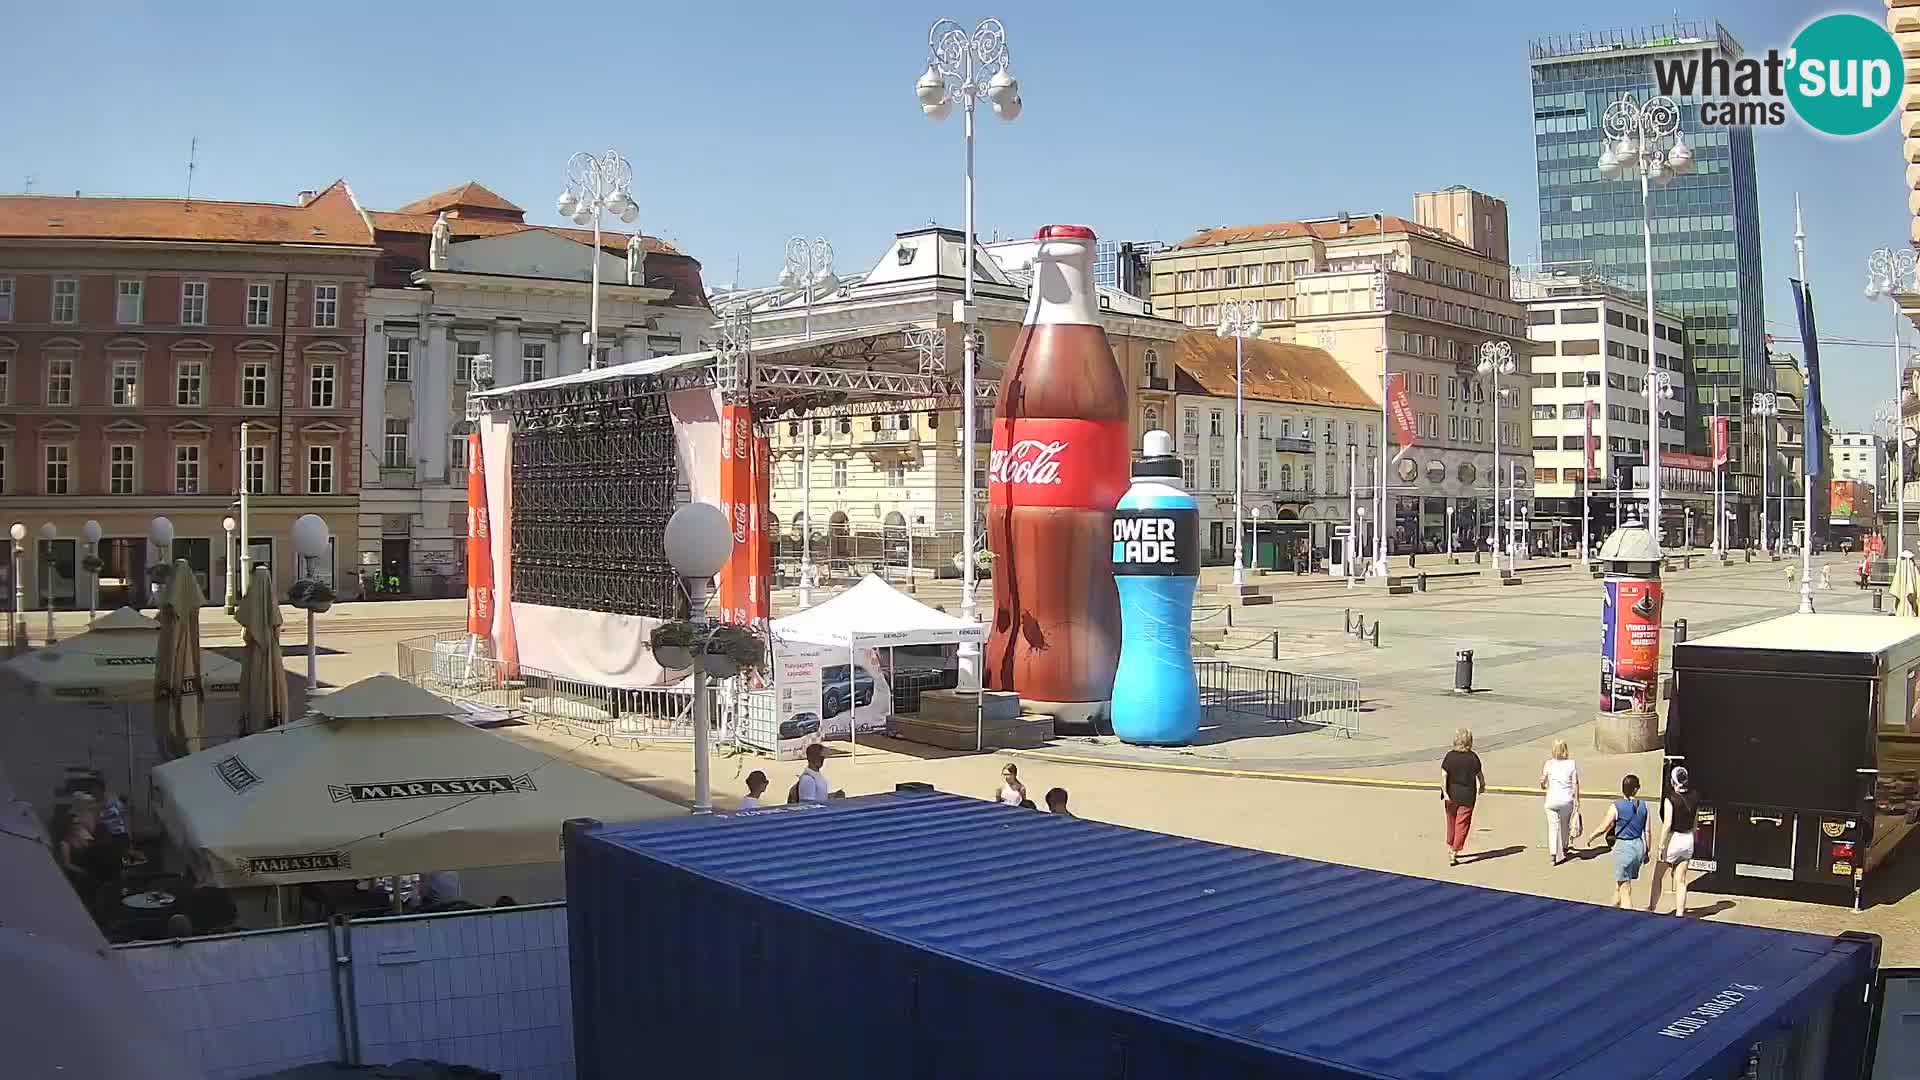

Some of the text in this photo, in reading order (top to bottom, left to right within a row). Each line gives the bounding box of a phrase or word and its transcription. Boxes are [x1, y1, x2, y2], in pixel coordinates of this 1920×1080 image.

[1113, 518, 1175, 541] OWER
[361, 779, 505, 799] MARASKA
[252, 854, 334, 873] MARASKA
[1691, 990, 1745, 1018] 300629
